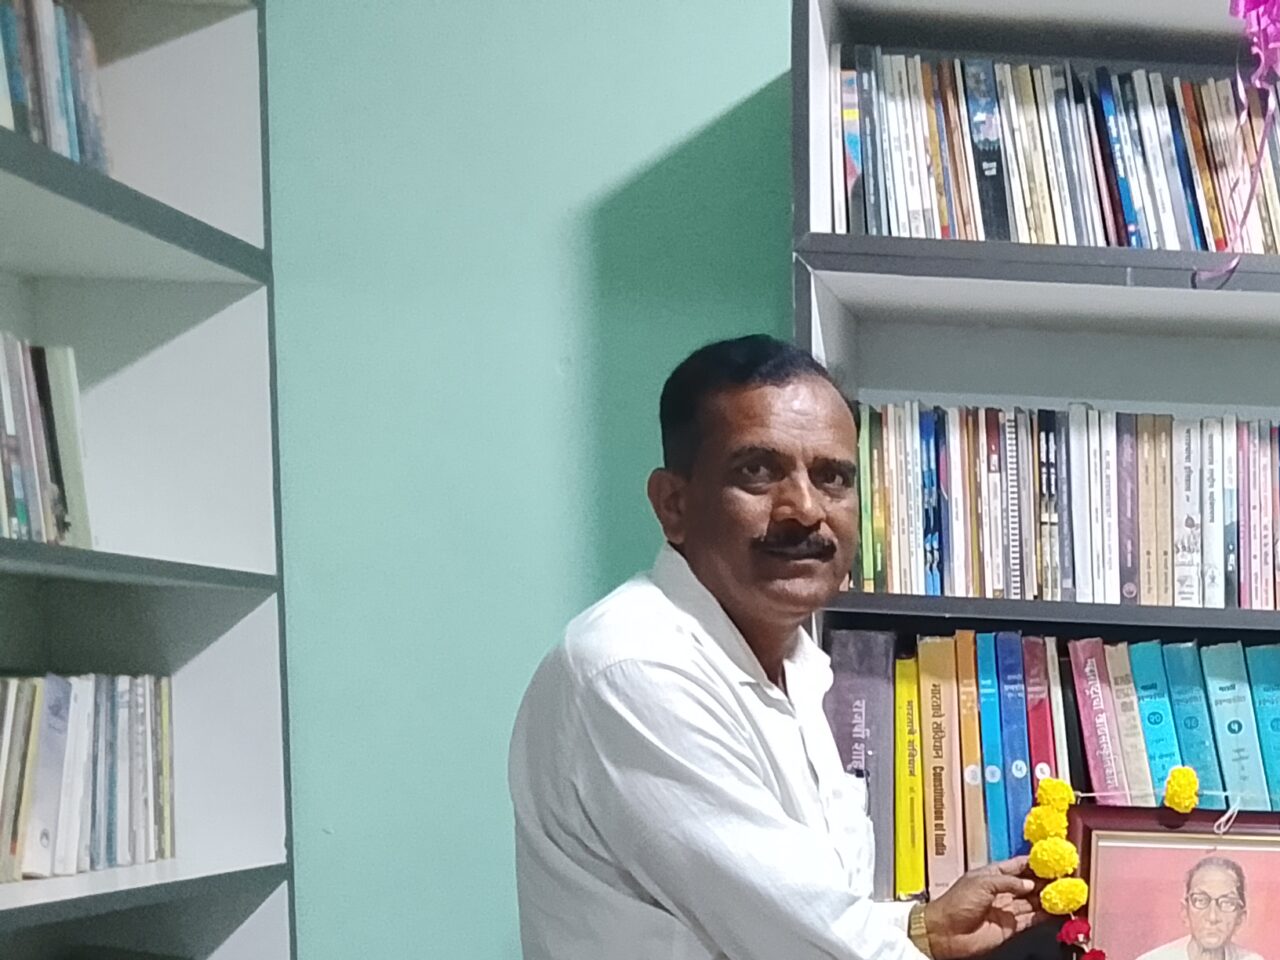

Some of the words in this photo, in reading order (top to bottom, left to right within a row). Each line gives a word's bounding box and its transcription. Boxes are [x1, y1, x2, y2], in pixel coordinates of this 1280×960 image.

[931, 683, 945, 718] भारताचे
[931, 720, 945, 759] संविधान
[932, 766, 945, 821] Constitution
[934, 822, 946, 832] of
[934, 833, 947, 857] India
